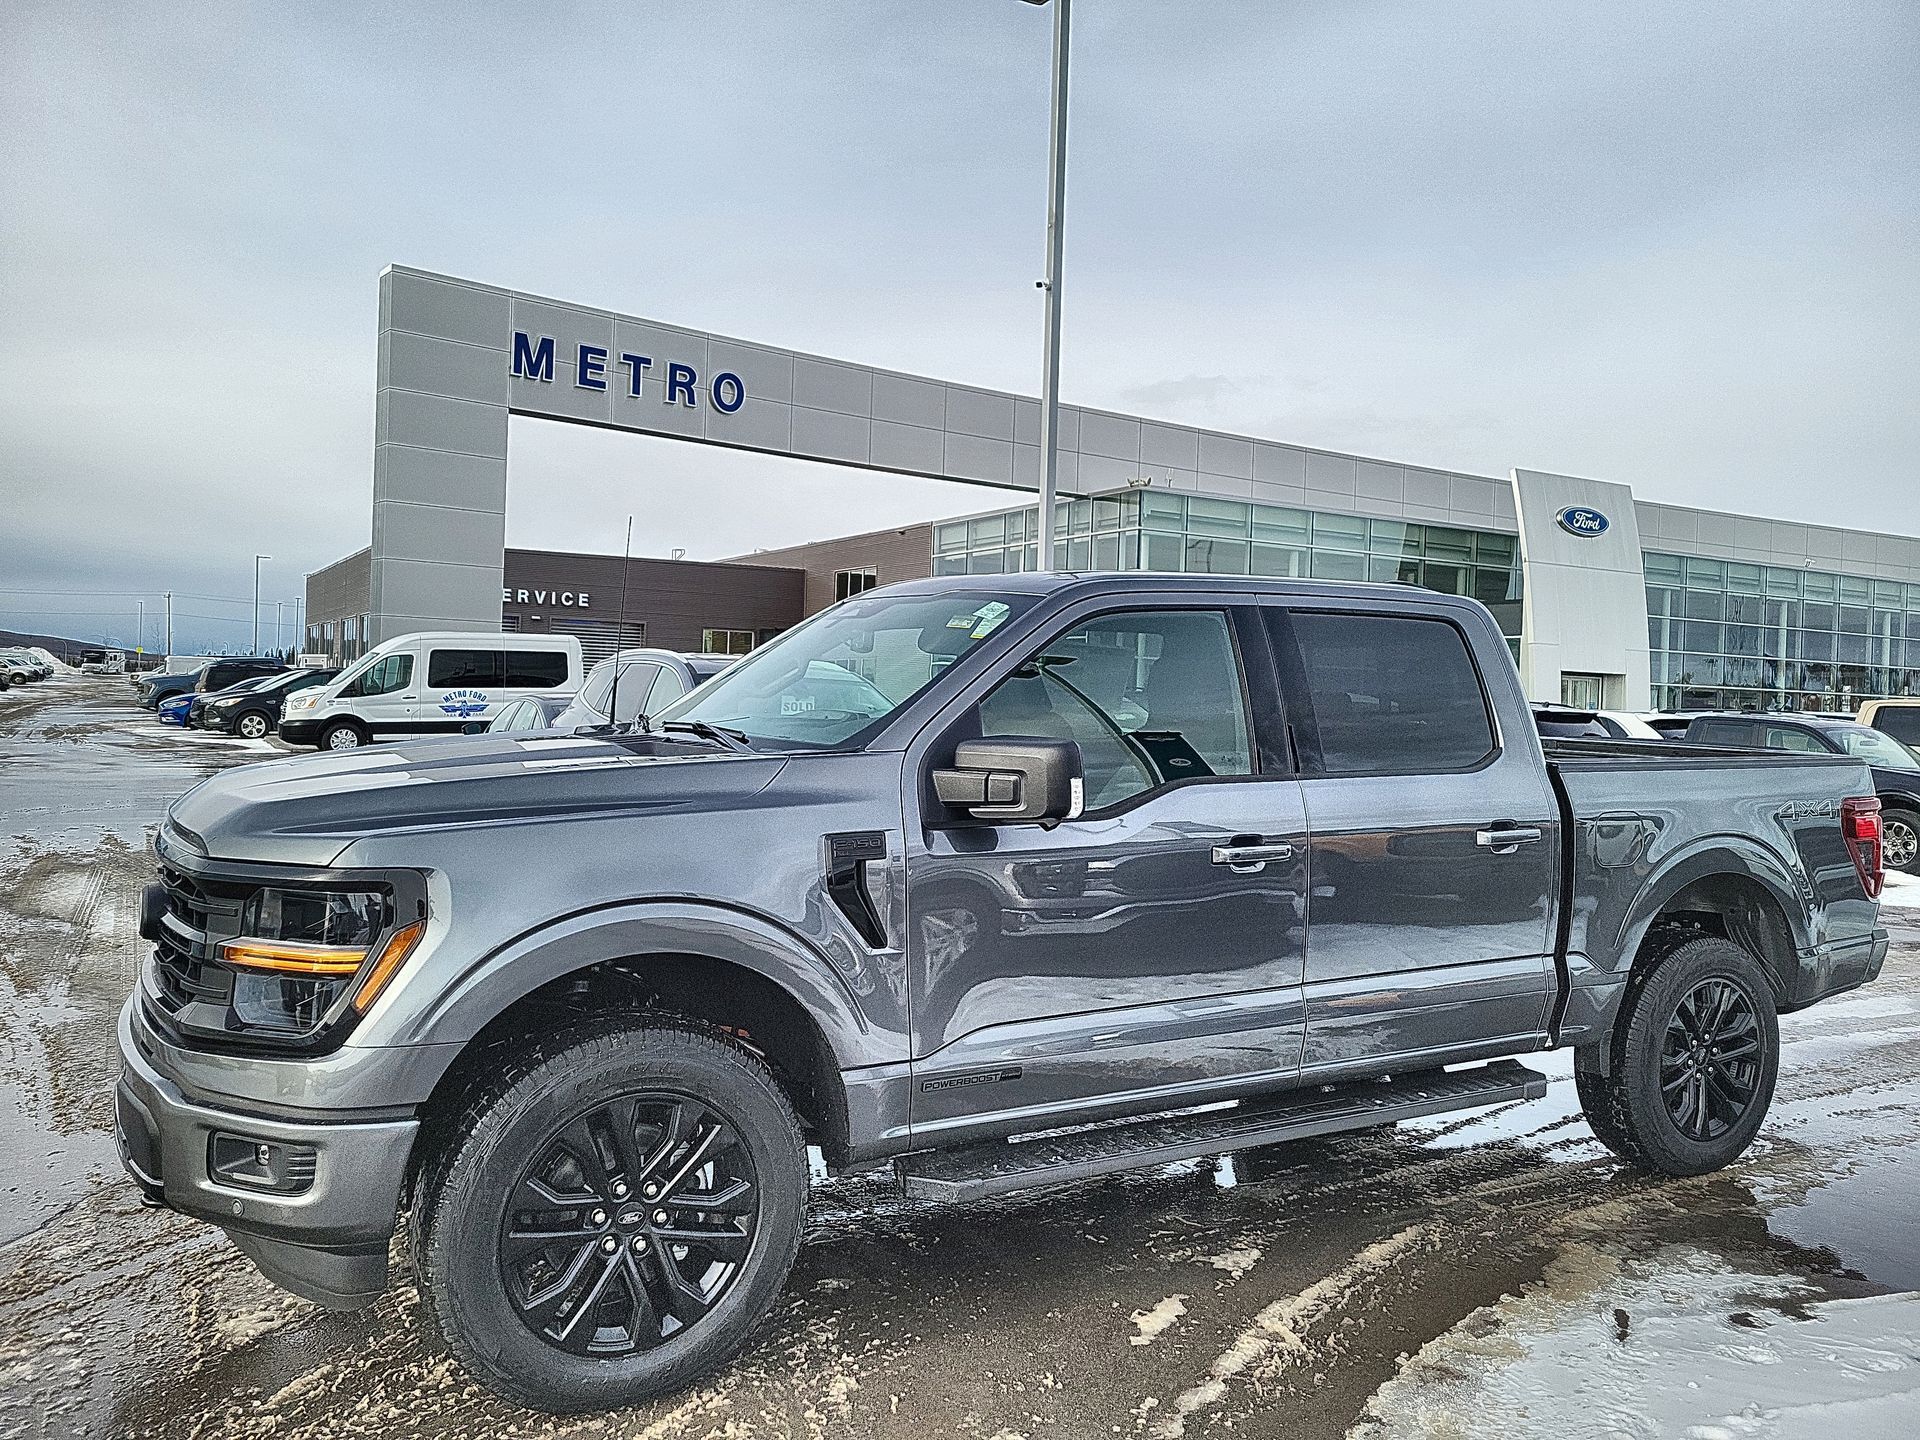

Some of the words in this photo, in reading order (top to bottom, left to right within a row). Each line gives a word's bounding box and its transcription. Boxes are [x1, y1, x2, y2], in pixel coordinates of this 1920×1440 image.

[510, 331, 746, 414] METRO
[1573, 511, 1600, 530] Ford
[502, 588, 589, 607] ERVICE
[443, 690, 467, 703] METRO
[469, 690, 487, 702] FORD
[783, 702, 813, 711] SOLD
[833, 839, 881, 849] F-150
[924, 1073, 1000, 1091] POWERBOOST
